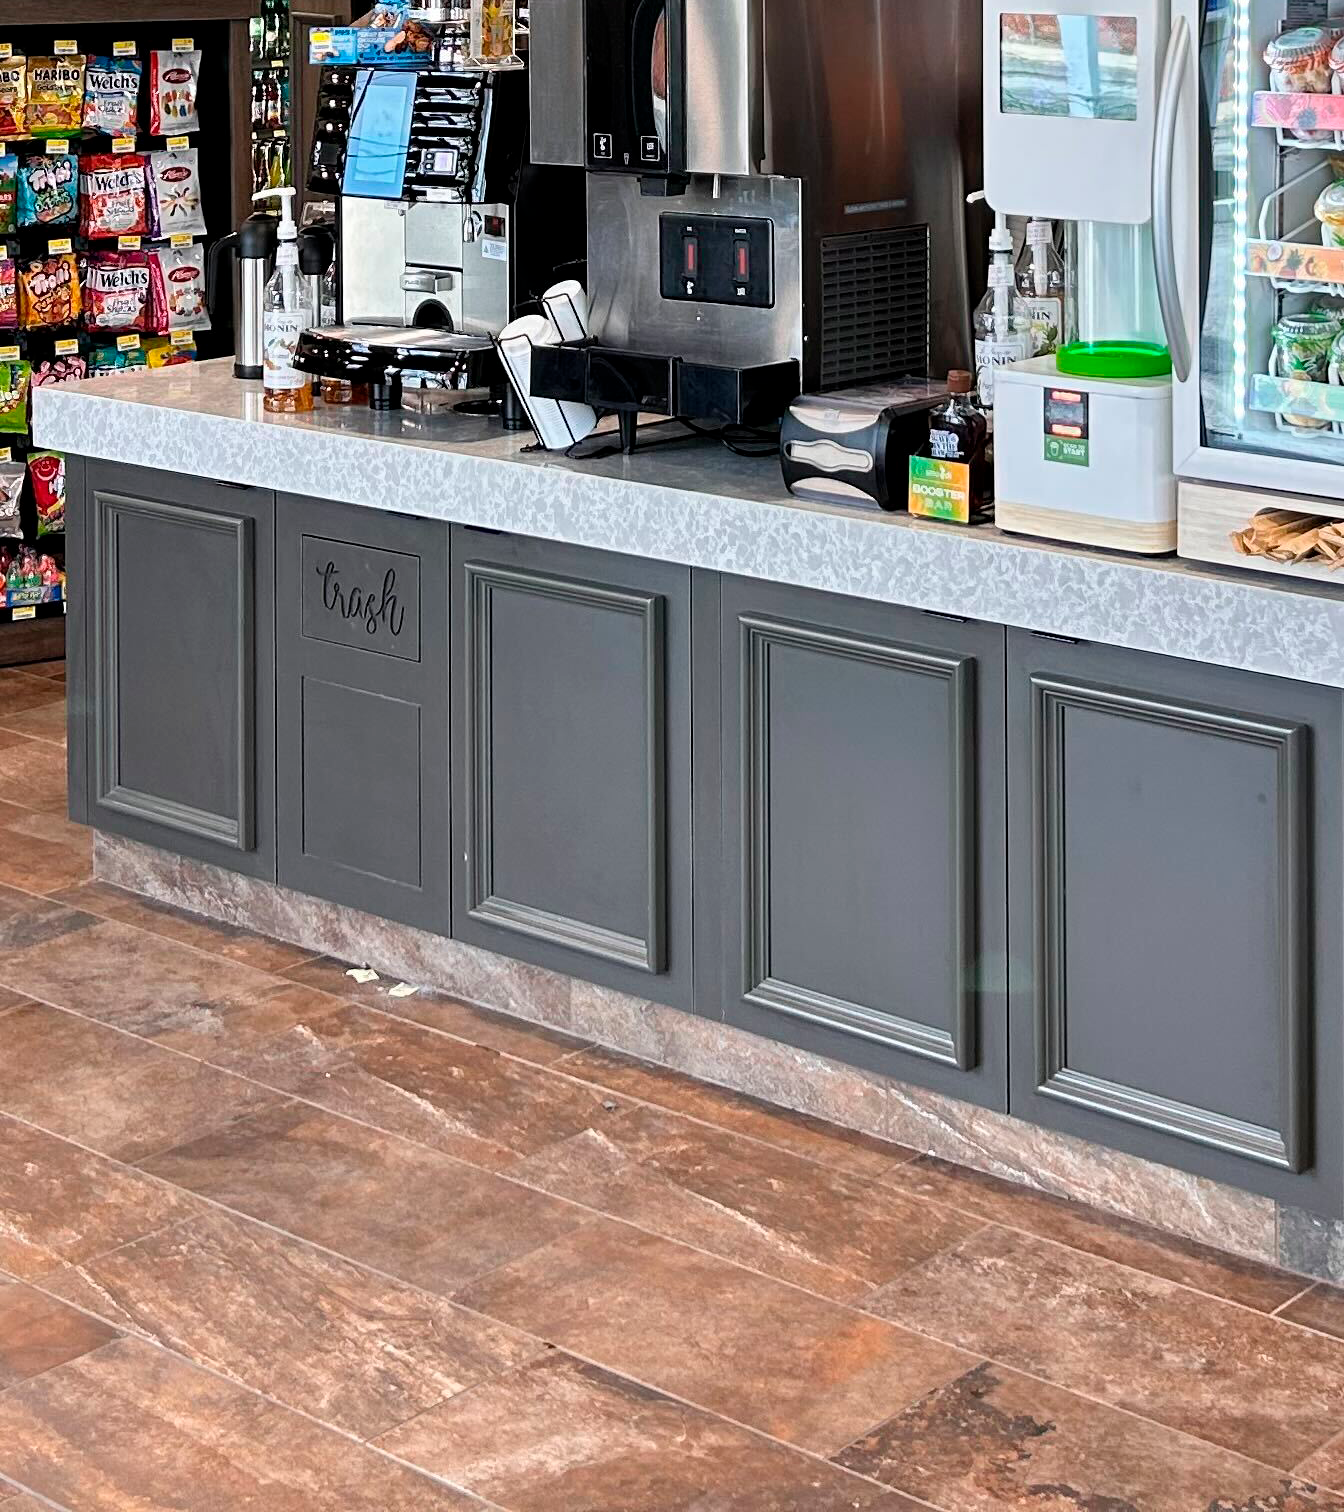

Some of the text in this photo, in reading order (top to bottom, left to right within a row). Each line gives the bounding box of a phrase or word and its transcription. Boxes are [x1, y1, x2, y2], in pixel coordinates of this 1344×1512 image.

[34, 69, 81, 81] HARIBO
[89, 74, 139, 89] Welch's
[100, 271, 148, 288] Welch's
[912, 483, 966, 501] BOOSTER
[924, 497, 953, 512] BAR
[316, 561, 404, 636] trash
